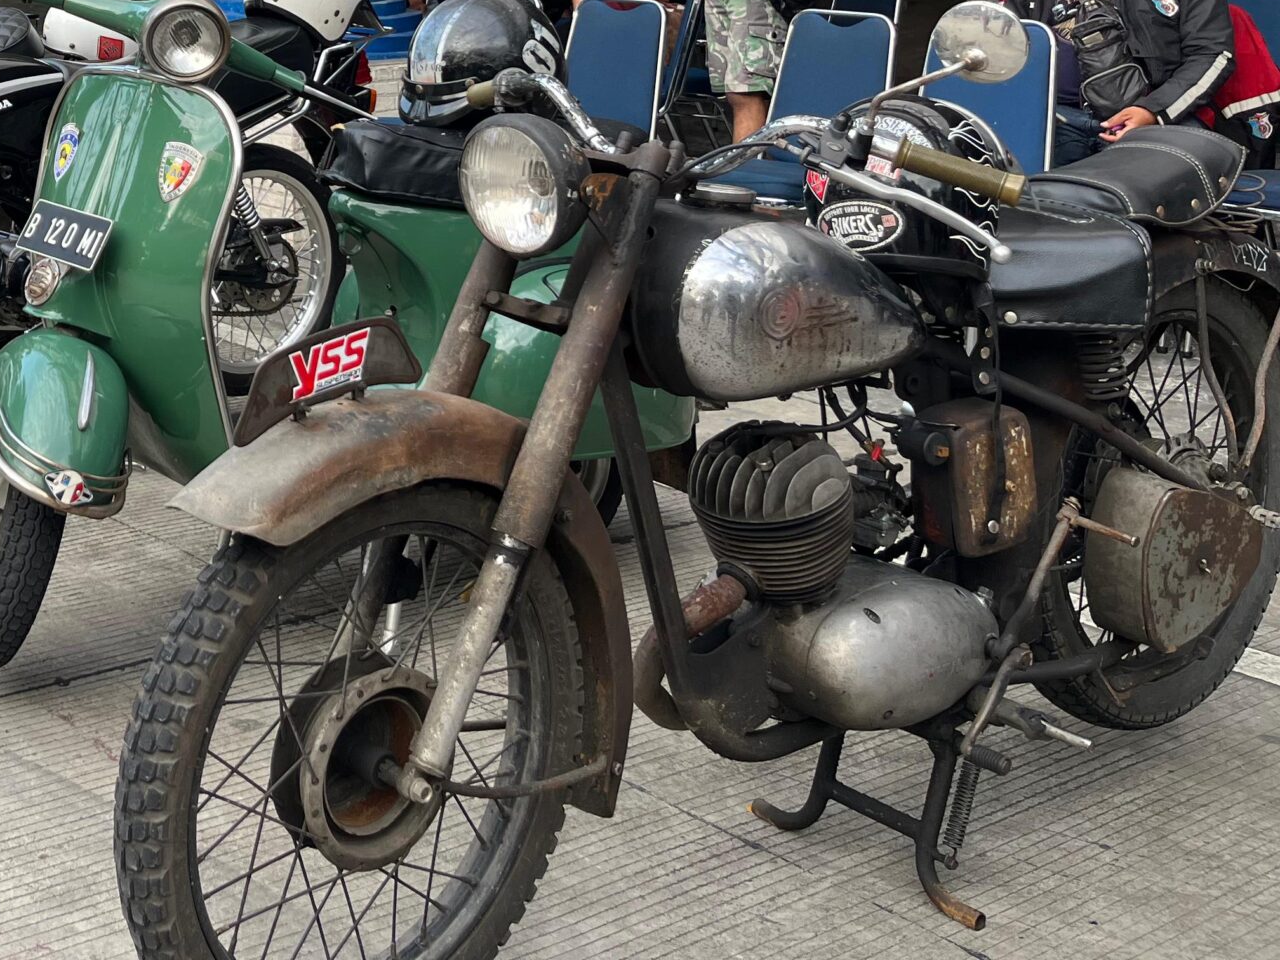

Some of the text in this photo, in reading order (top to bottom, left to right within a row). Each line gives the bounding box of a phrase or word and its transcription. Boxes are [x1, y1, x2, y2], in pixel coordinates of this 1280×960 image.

[824, 205, 880, 221] SUPPORT YOUR LOCAL
[831, 214, 879, 240] BIKERS
[23, 213, 40, 237] B
[43, 217, 77, 249] 120
[289, 327, 370, 400] YSS
